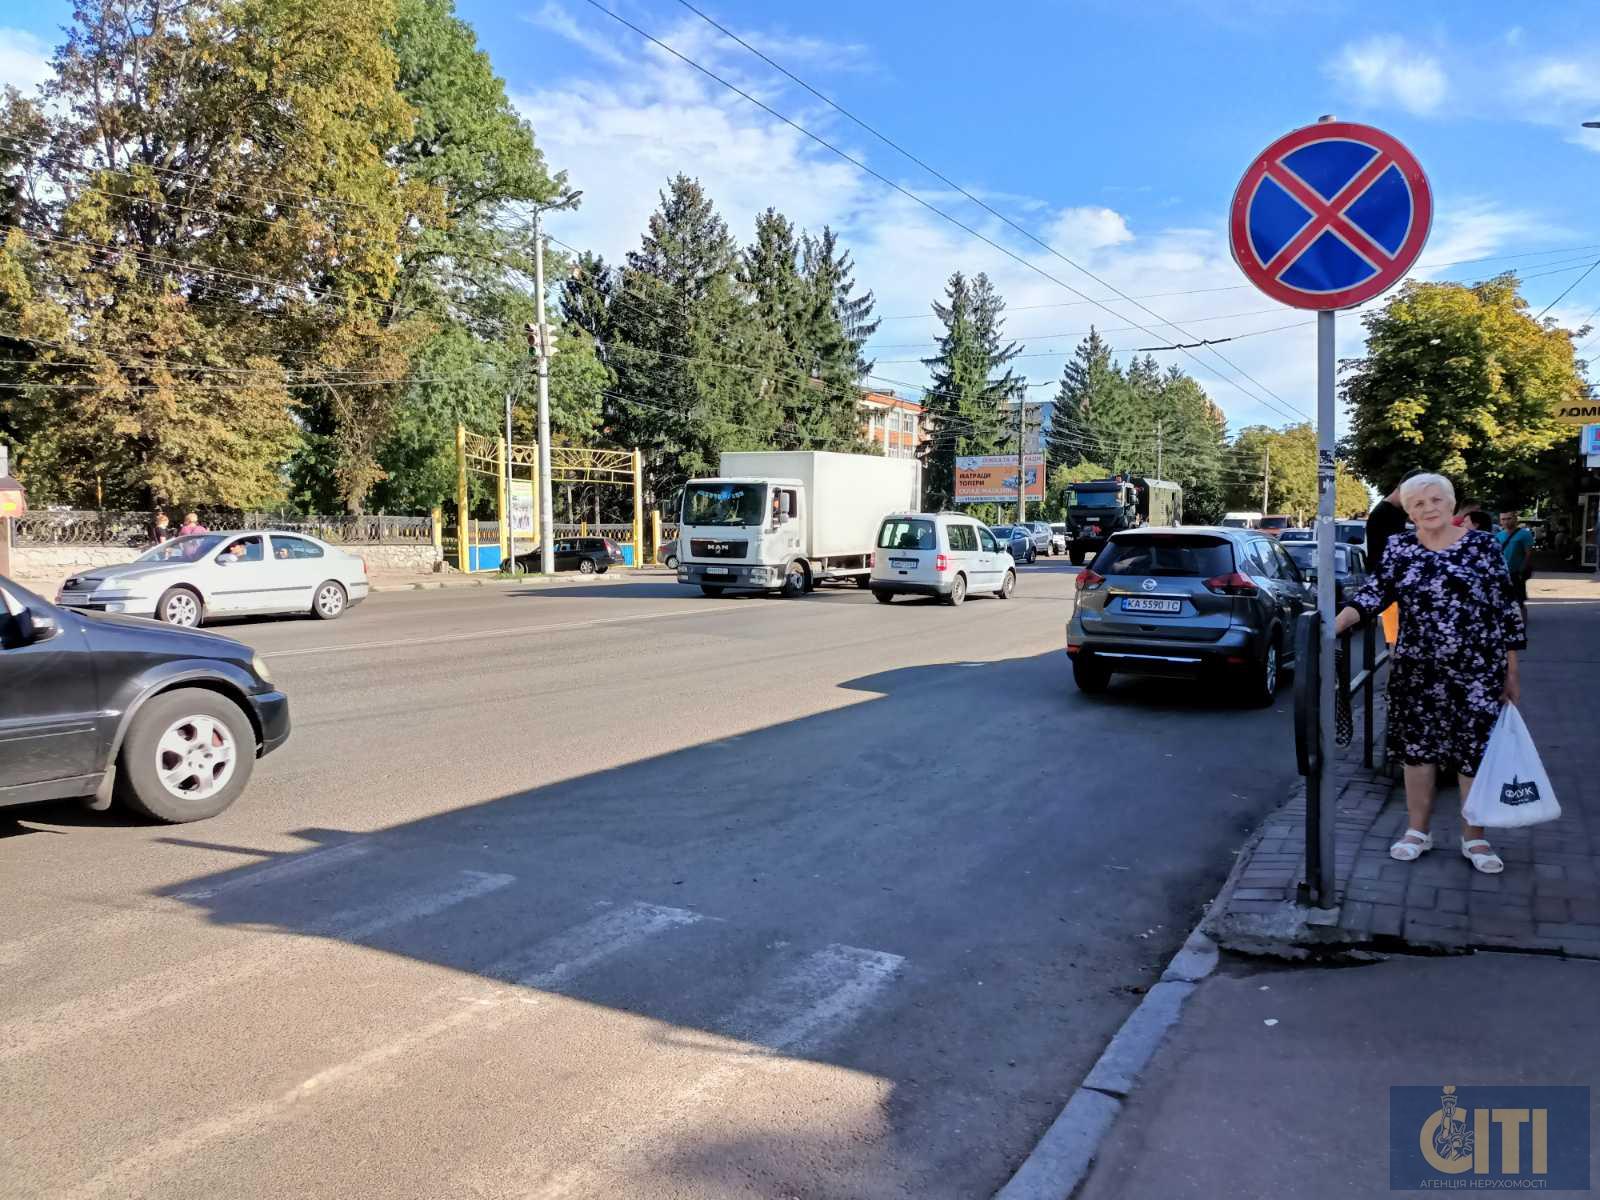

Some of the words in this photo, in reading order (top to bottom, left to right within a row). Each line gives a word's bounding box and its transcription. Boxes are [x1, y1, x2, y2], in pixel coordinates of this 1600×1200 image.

[1558, 406, 1600, 417] ЛОМ
[1128, 599, 1141, 609] KA
[1142, 600, 1164, 610] 5590
[1167, 601, 1179, 611] IC
